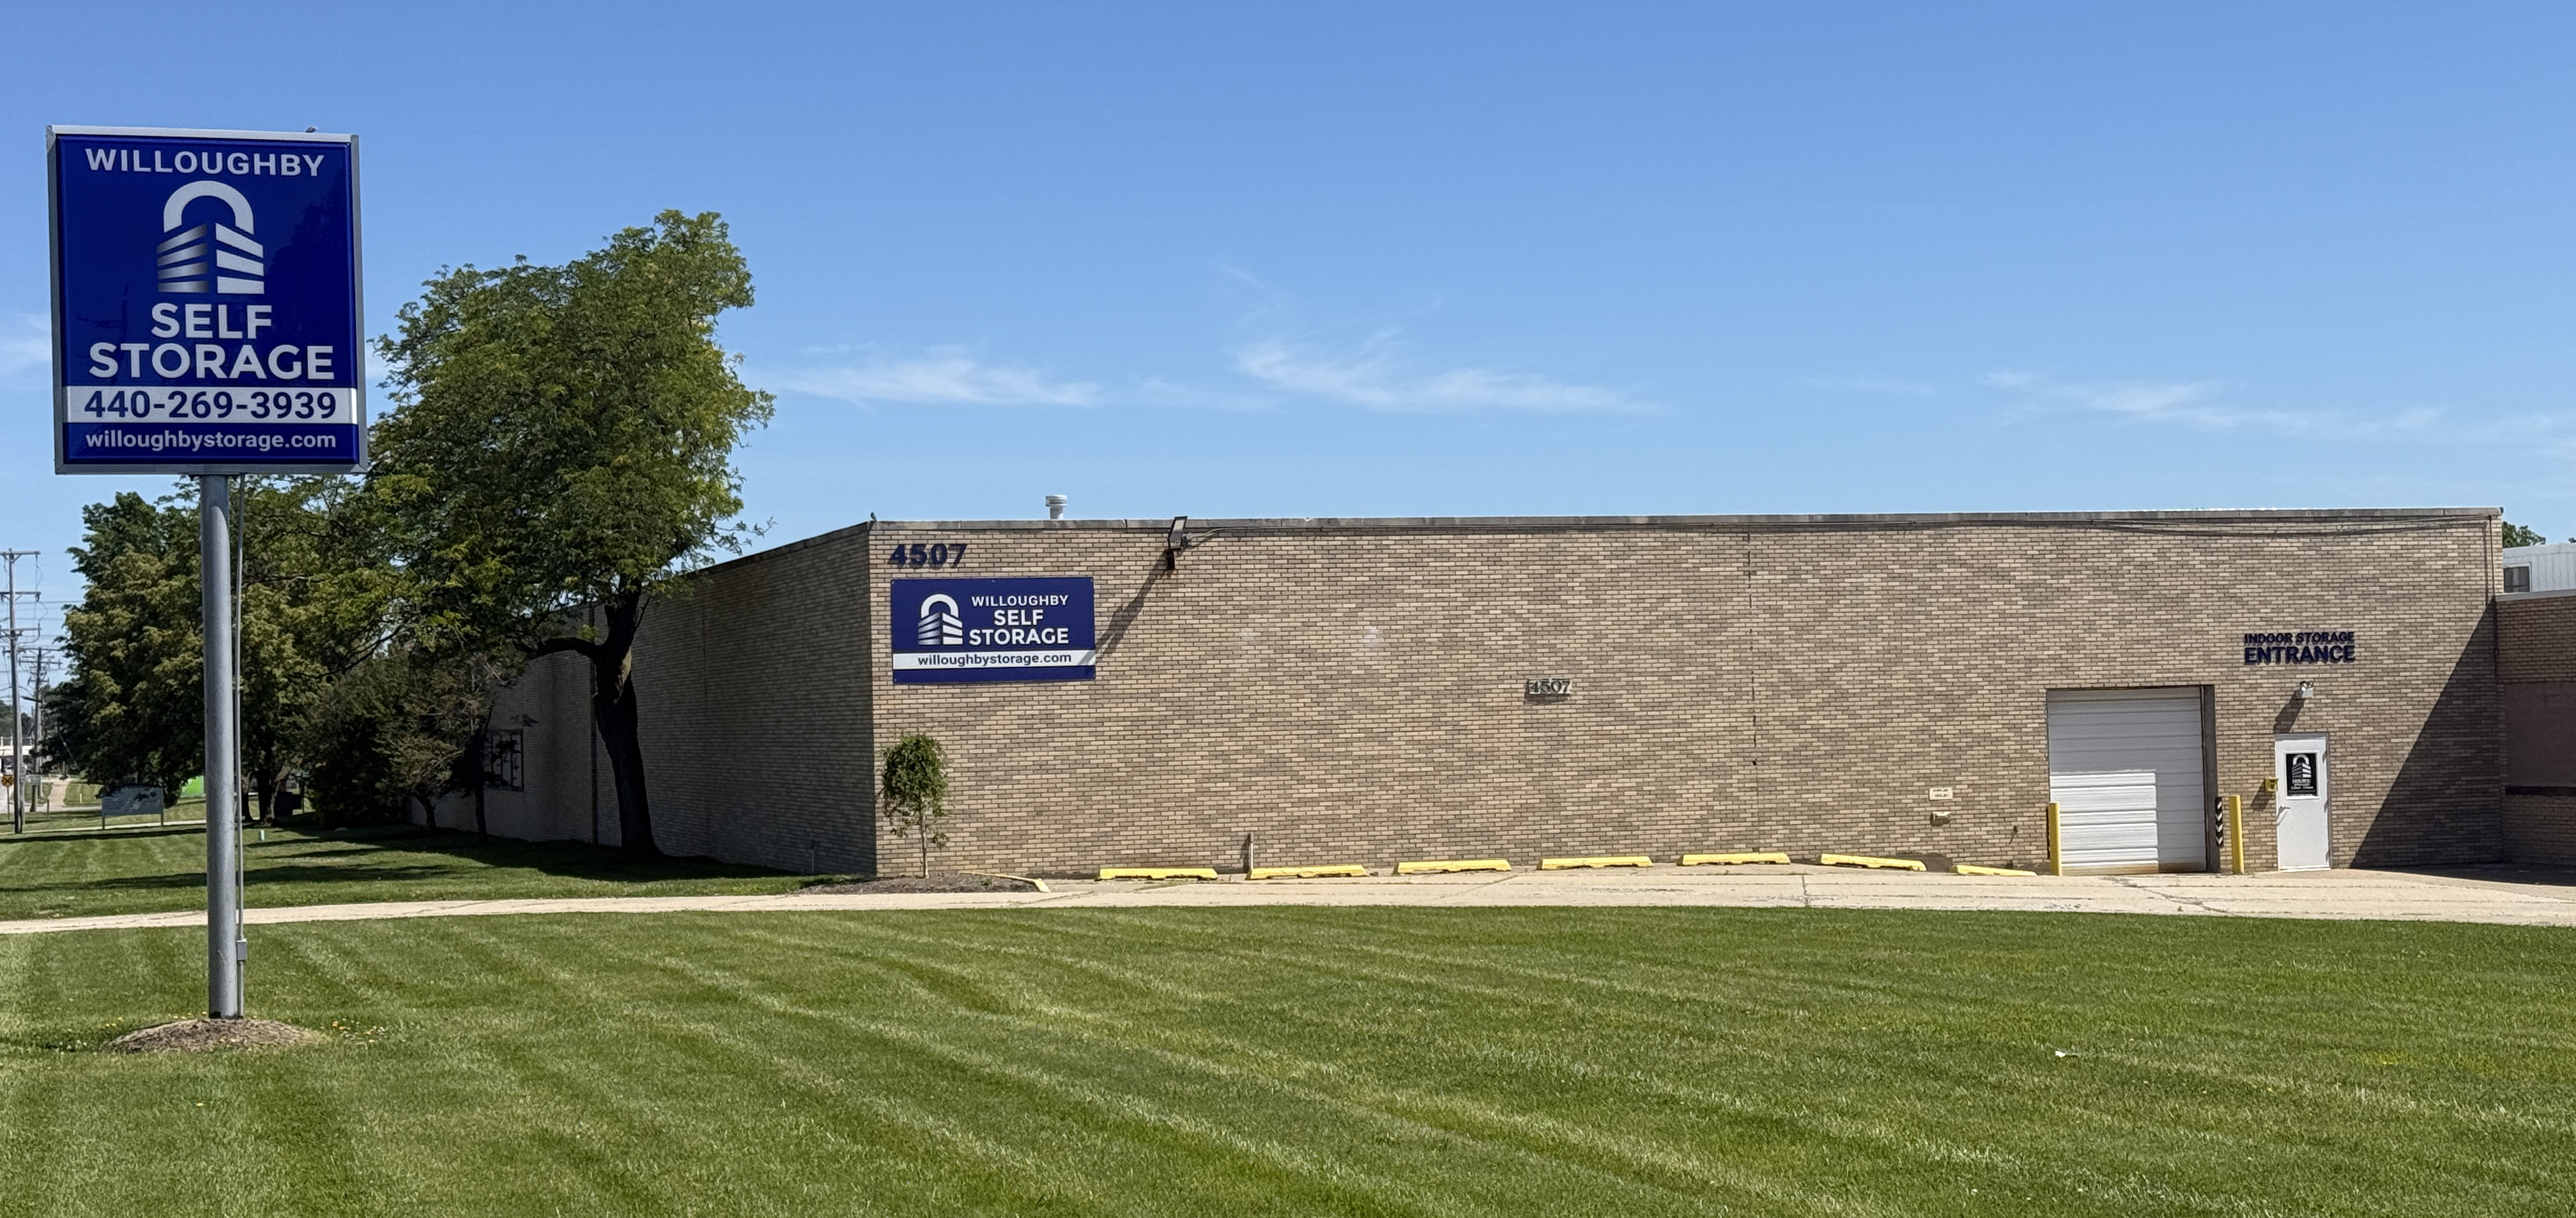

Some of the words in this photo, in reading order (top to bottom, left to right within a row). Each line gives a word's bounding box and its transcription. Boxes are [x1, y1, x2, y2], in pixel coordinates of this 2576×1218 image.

[85, 148, 324, 176] WILLOUGHBY
[151, 303, 272, 339] SELF
[89, 342, 334, 380] STORAGE
[84, 390, 337, 419] 440-269-3939
[86, 430, 336, 452] willoughbystorage.com
[888, 544, 967, 568] 4507
[971, 595, 1069, 607] WILLOUGHBY
[994, 609, 1044, 626] SELF
[969, 628, 1070, 646] STORAGE
[2244, 633, 2293, 644] INDOOR
[2296, 632, 2355, 643] STORAGE
[918, 653, 1071, 667] willoughbystorage.com
[2244, 645, 2356, 665] ENTRANCE
[1529, 680, 1570, 694] 4507
